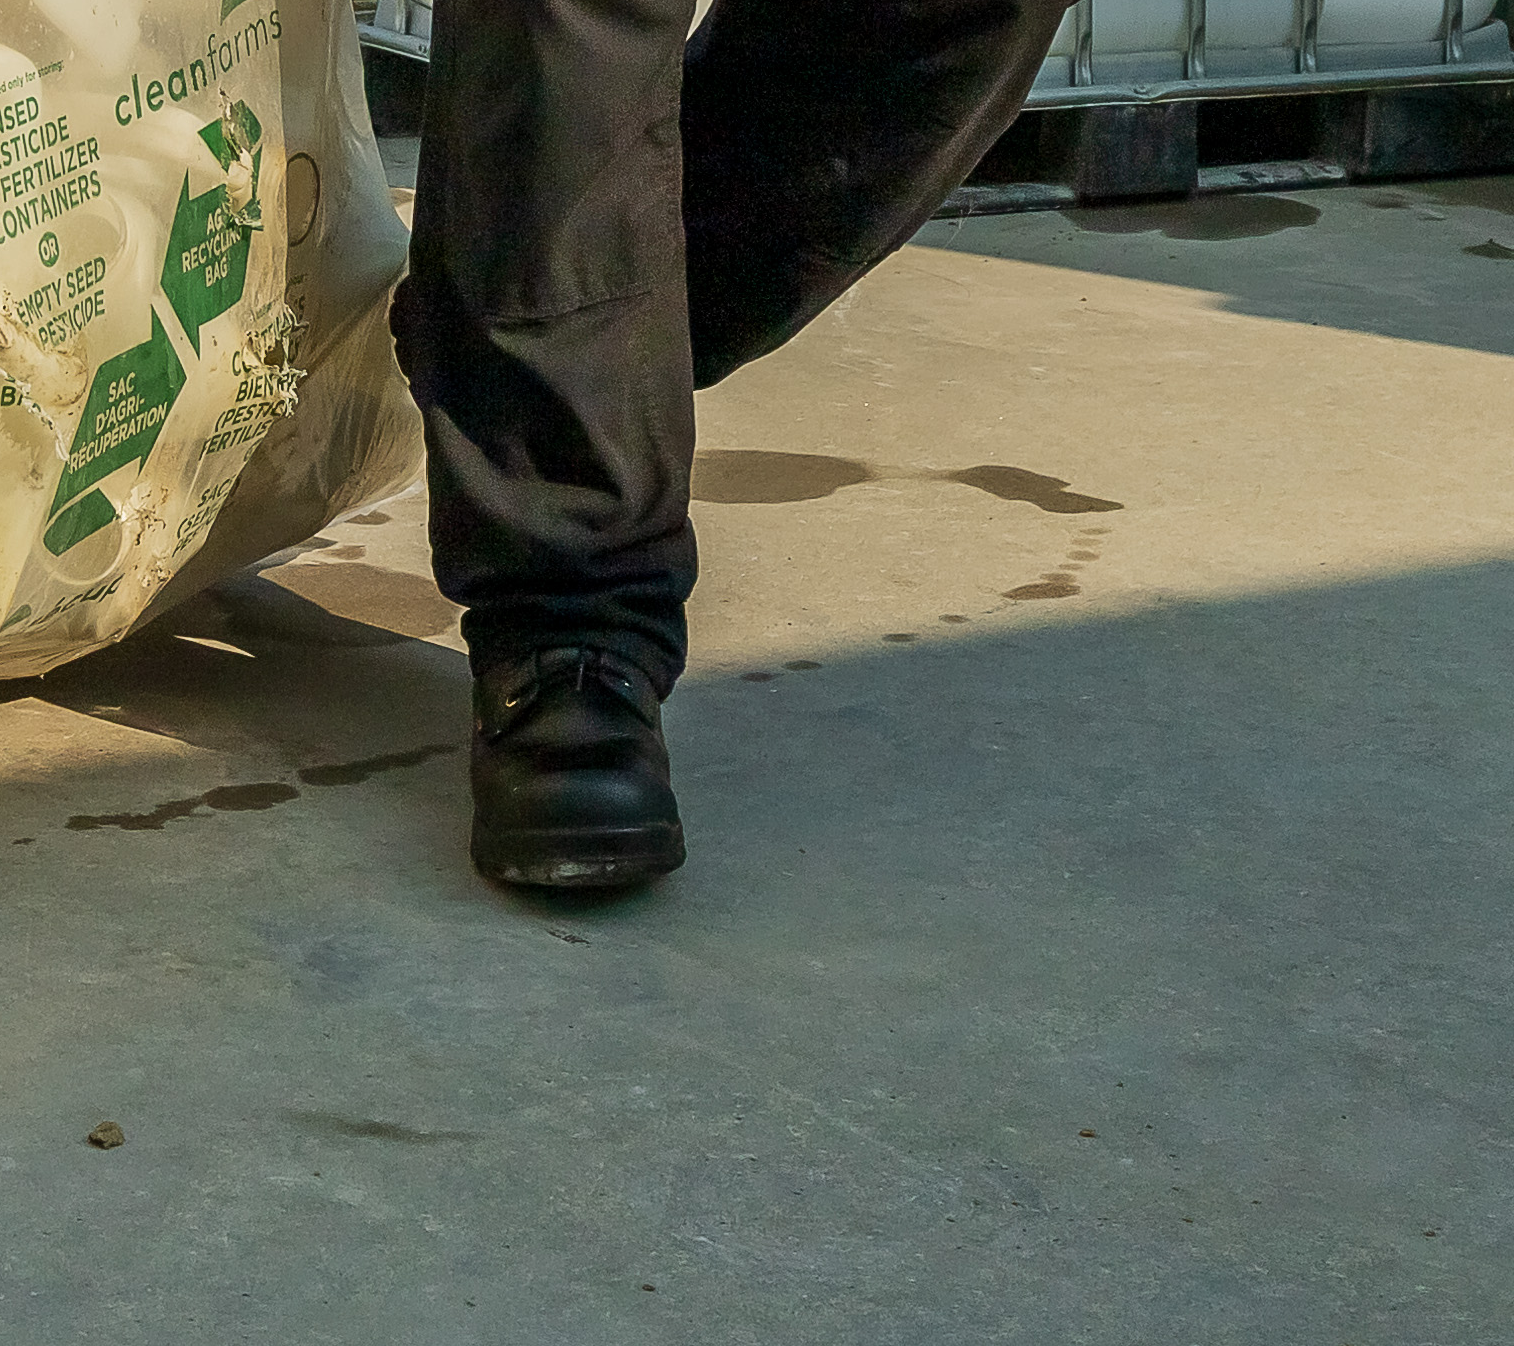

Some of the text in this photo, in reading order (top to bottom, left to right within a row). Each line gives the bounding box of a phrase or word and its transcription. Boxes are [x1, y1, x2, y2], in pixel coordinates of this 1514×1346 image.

[8, 75, 24, 91] only
[25, 70, 36, 84] for
[114, 8, 282, 127] cleanfarms
[0, 136, 101, 203] FERTILIZER
[16, 256, 106, 328] EMPTY SEED
[204, 256, 228, 288] BAG
[38, 289, 106, 351] PESTICIDE
[94, 392, 146, 435] D'AGRI-
[107, 370, 137, 403] SAC
[69, 400, 169, 475] RÉCUPÉRATION
